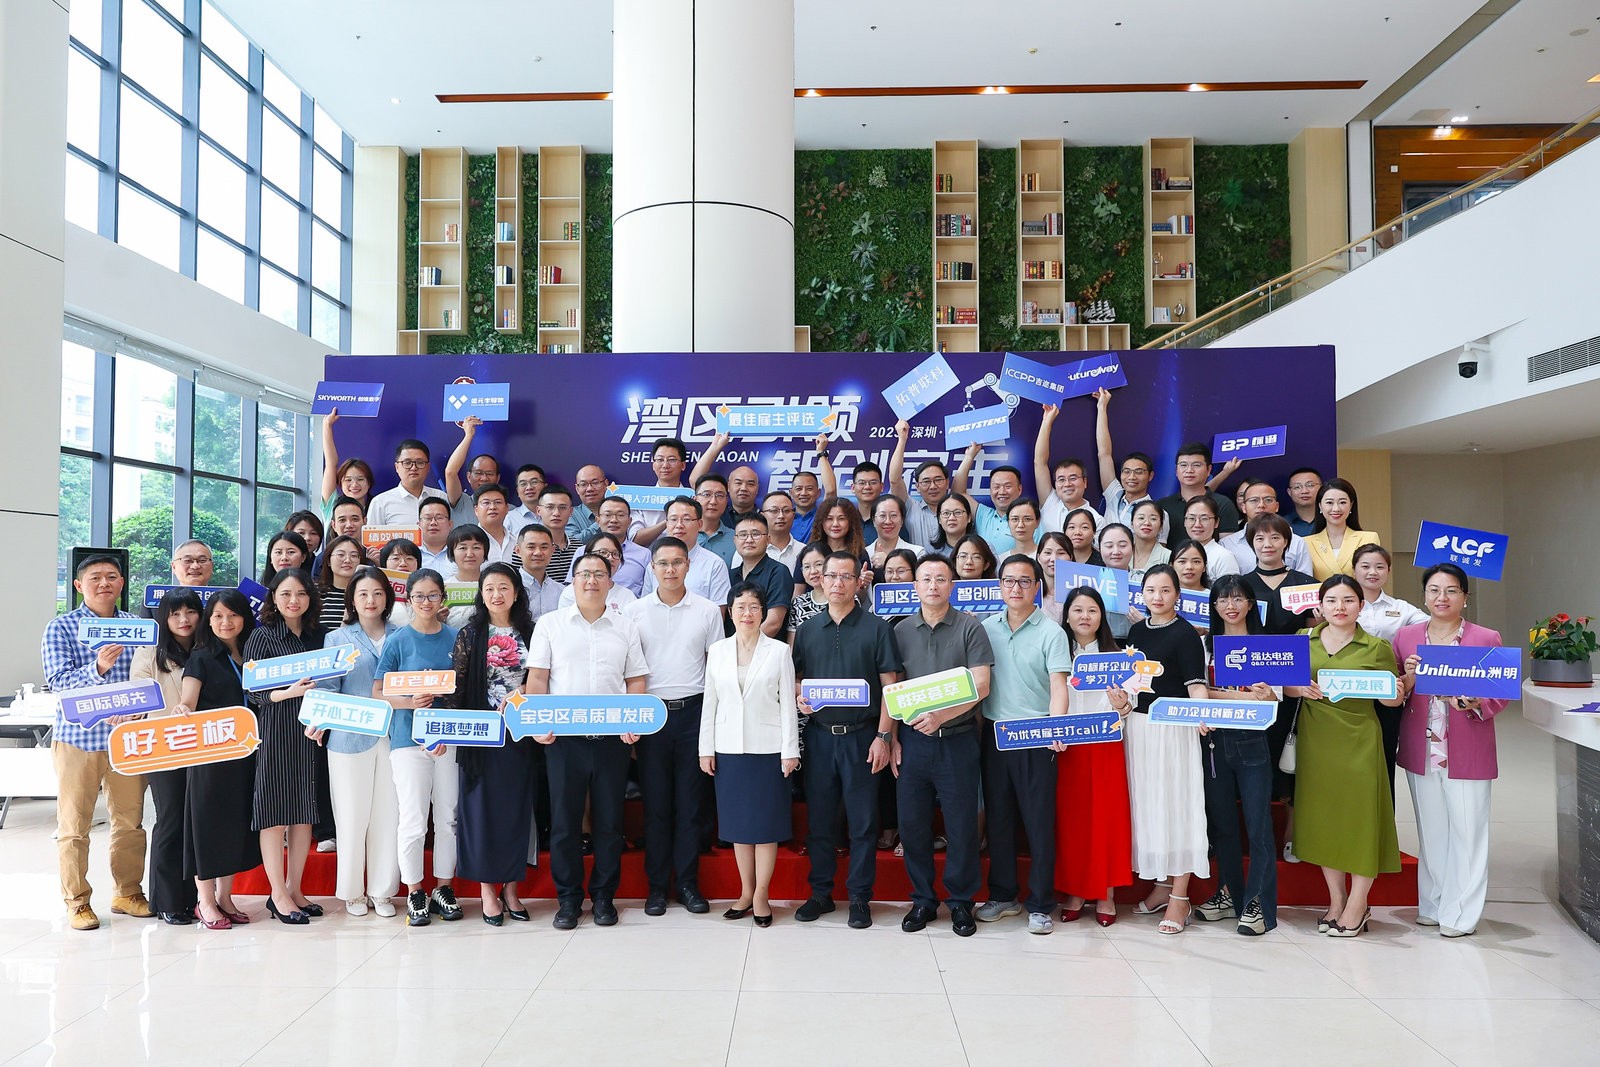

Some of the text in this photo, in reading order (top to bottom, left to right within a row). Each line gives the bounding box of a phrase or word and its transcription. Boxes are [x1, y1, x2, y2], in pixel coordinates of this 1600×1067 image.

[895, 366, 944, 406] 拓普联科
[317, 394, 356, 402] SKYWORTH
[728, 412, 816, 427] 最佳雇主评选
[1221, 437, 1250, 452] BP
[716, 451, 759, 463] AOAN
[1450, 535, 1496, 558] LCF
[87, 626, 147, 639] 雇主文化
[1250, 651, 1294, 661] 强达电路
[1077, 661, 1131, 672] 向标杆企业
[1326, 678, 1385, 692] 人才发展
[808, 687, 860, 700] 创新发展
[896, 681, 961, 709] 群英荟萃
[75, 691, 148, 715] 国际领先
[312, 702, 376, 724] 开心工作
[520, 707, 655, 724] 宝安区高质量发展
[1167, 705, 1258, 720] 助力企业创新成长
[425, 720, 490, 737] 追逐梦想
[122, 717, 238, 758] 好老板
